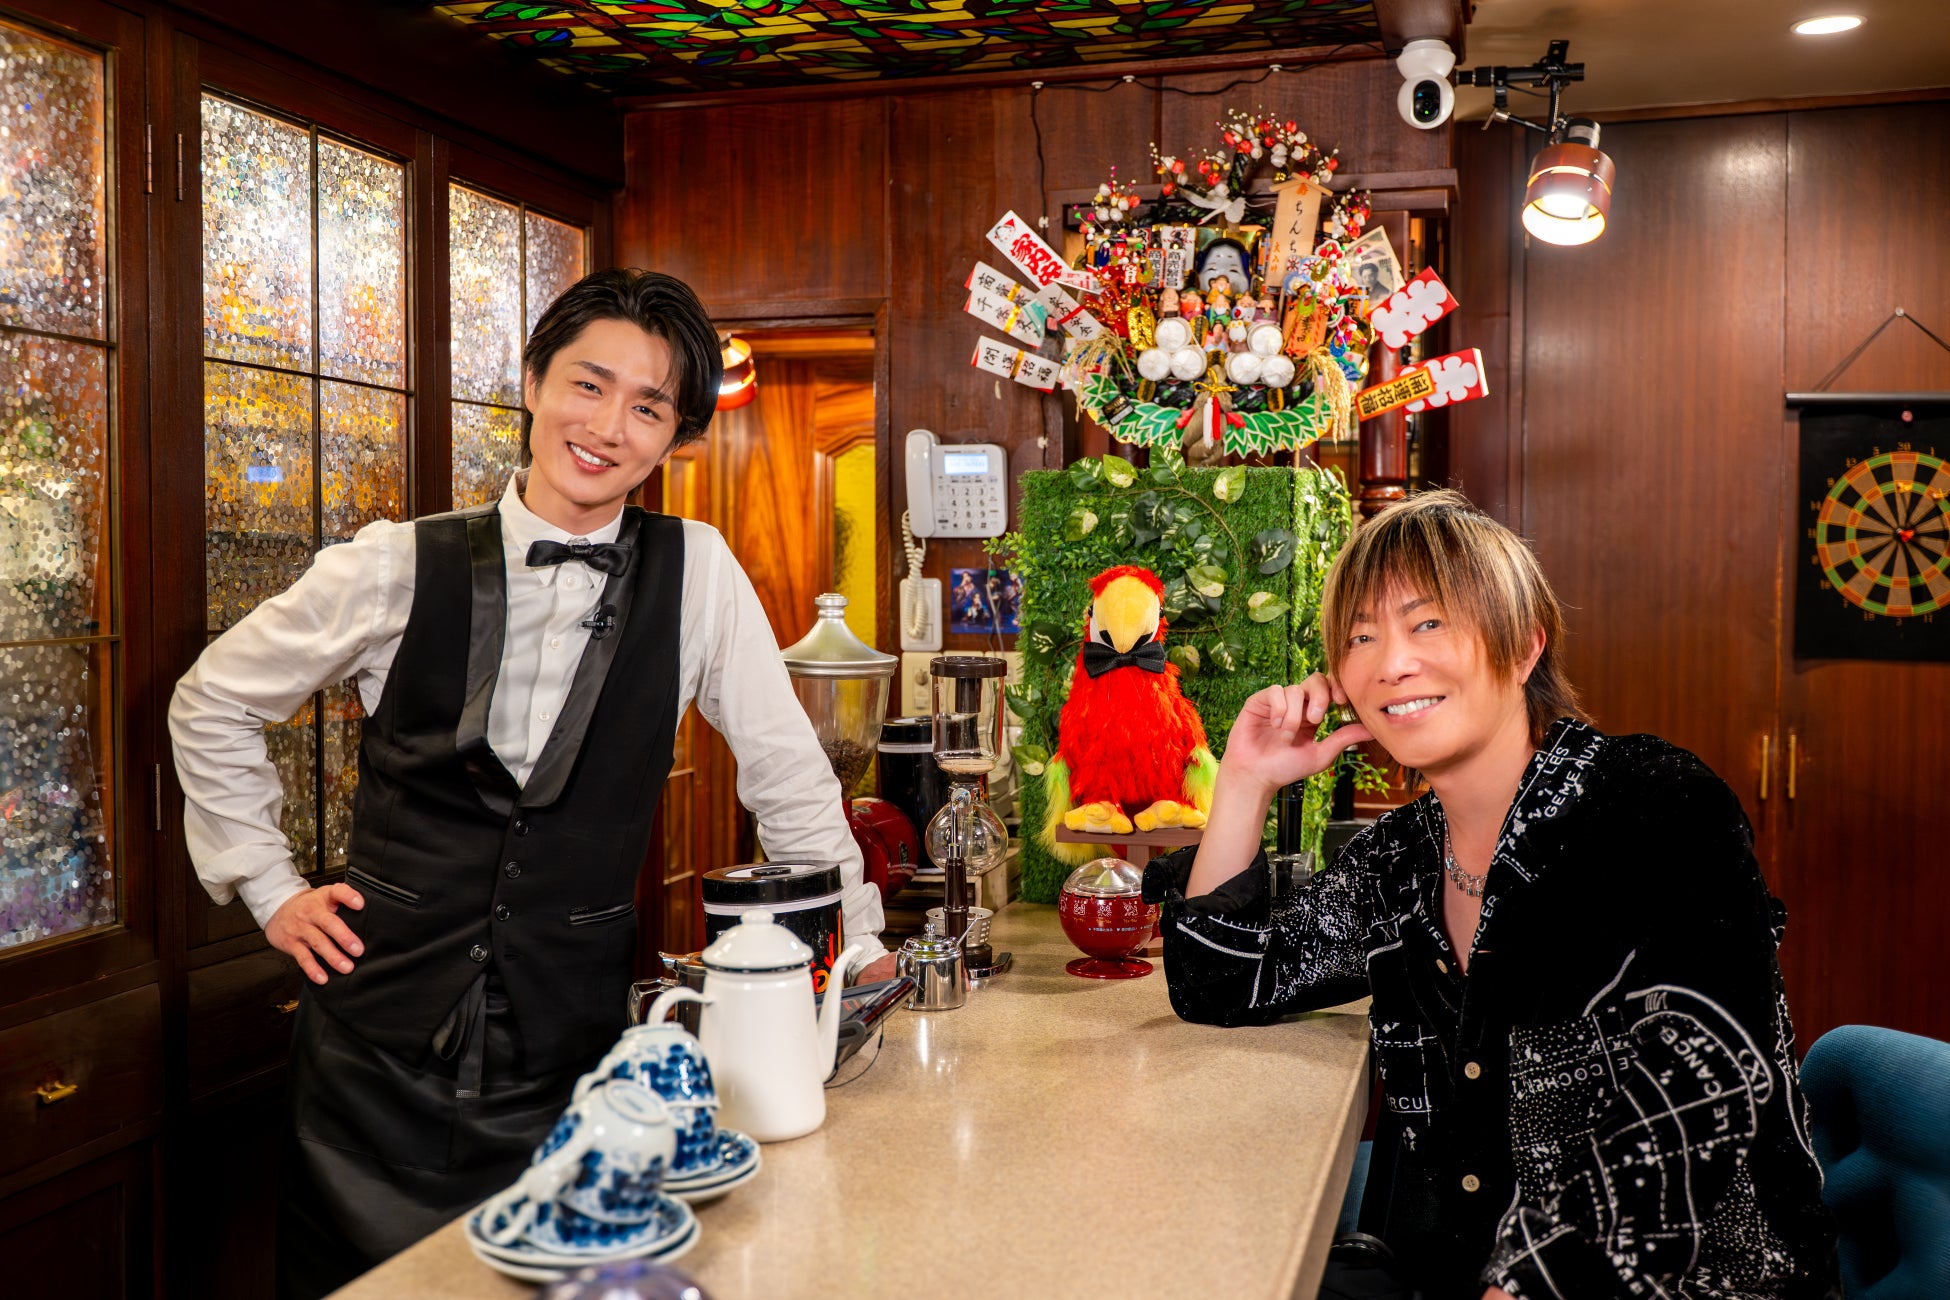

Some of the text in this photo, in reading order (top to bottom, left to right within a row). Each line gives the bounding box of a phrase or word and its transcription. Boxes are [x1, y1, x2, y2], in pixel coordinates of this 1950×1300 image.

[1360, 373, 1429, 415] 開運招福
[1543, 746, 1570, 775] LES
[1713, 1104, 1730, 1133] LE
